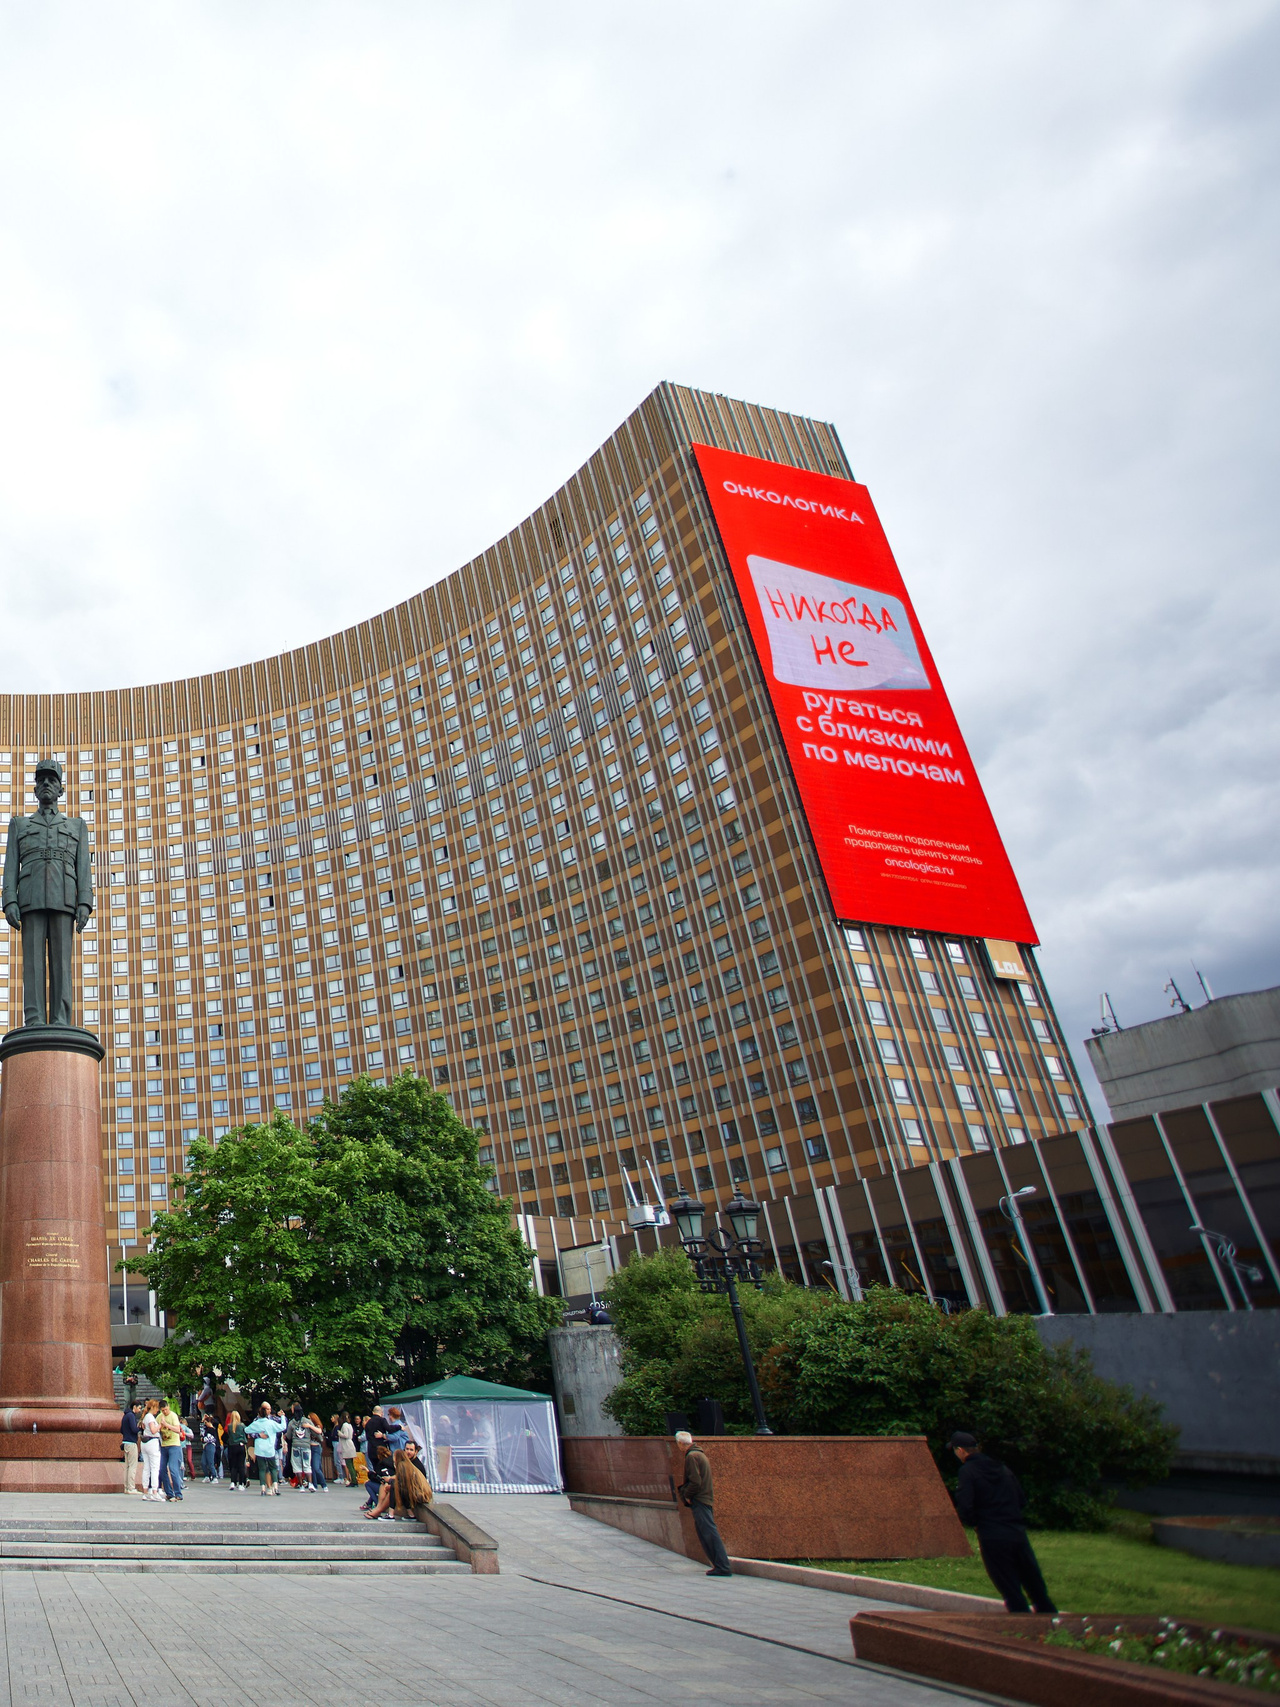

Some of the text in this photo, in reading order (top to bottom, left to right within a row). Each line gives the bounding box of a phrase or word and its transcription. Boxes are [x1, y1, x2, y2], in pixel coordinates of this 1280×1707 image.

[722, 481, 865, 524] ОНКОЛОГИКА
[763, 585, 898, 634] НИКОГДА
[801, 691, 923, 728] ругаться
[796, 714, 954, 758] с близкими
[801, 742, 966, 786] по мелочам
[844, 837, 983, 865] продолжать ценить жизнь
[848, 824, 971, 852] Помогаем подопечным
[884, 858, 955, 876] oncologica.ru
